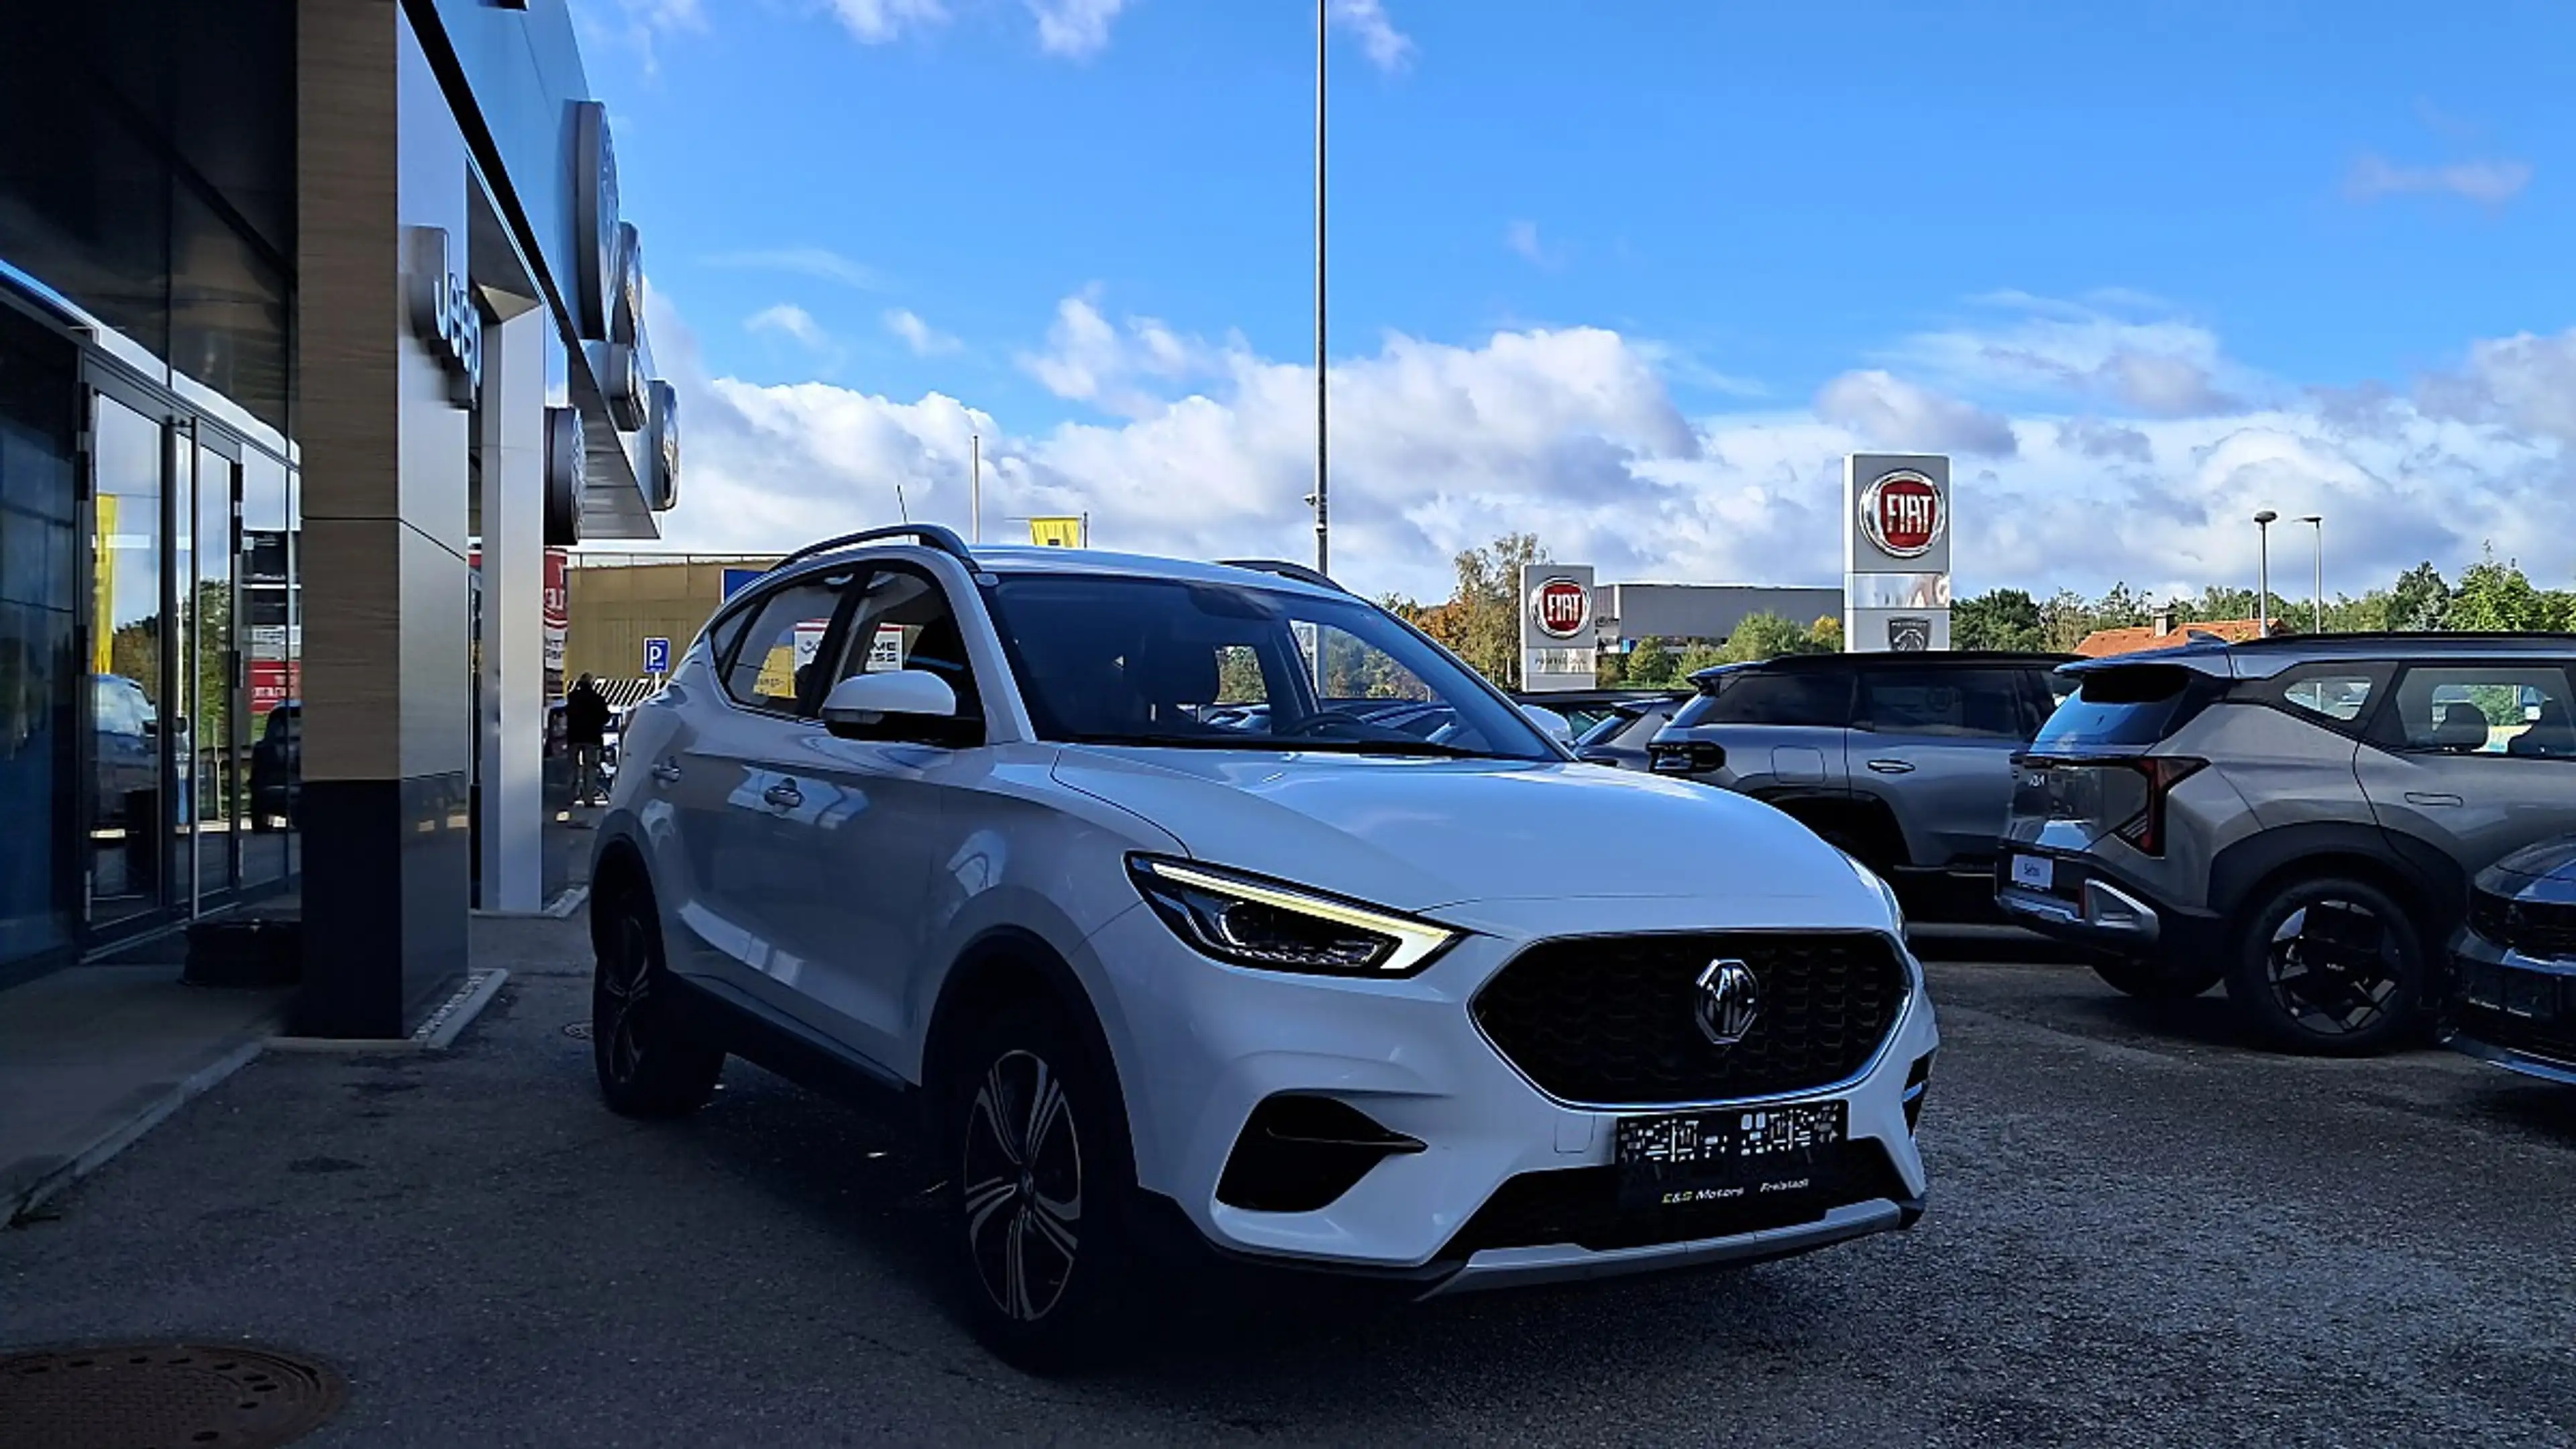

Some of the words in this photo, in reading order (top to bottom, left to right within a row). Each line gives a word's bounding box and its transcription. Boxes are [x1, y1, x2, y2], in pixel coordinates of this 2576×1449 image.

[433, 225, 482, 411] Jeep
[1886, 494, 1933, 534] FIAT
[1547, 594, 1581, 622] FIAT
[649, 645, 663, 667] P
[870, 653, 896, 661] SS
[873, 641, 896, 651] ME
[1707, 967, 1754, 1034] MG
[1696, 1187, 1744, 1200] Motors
